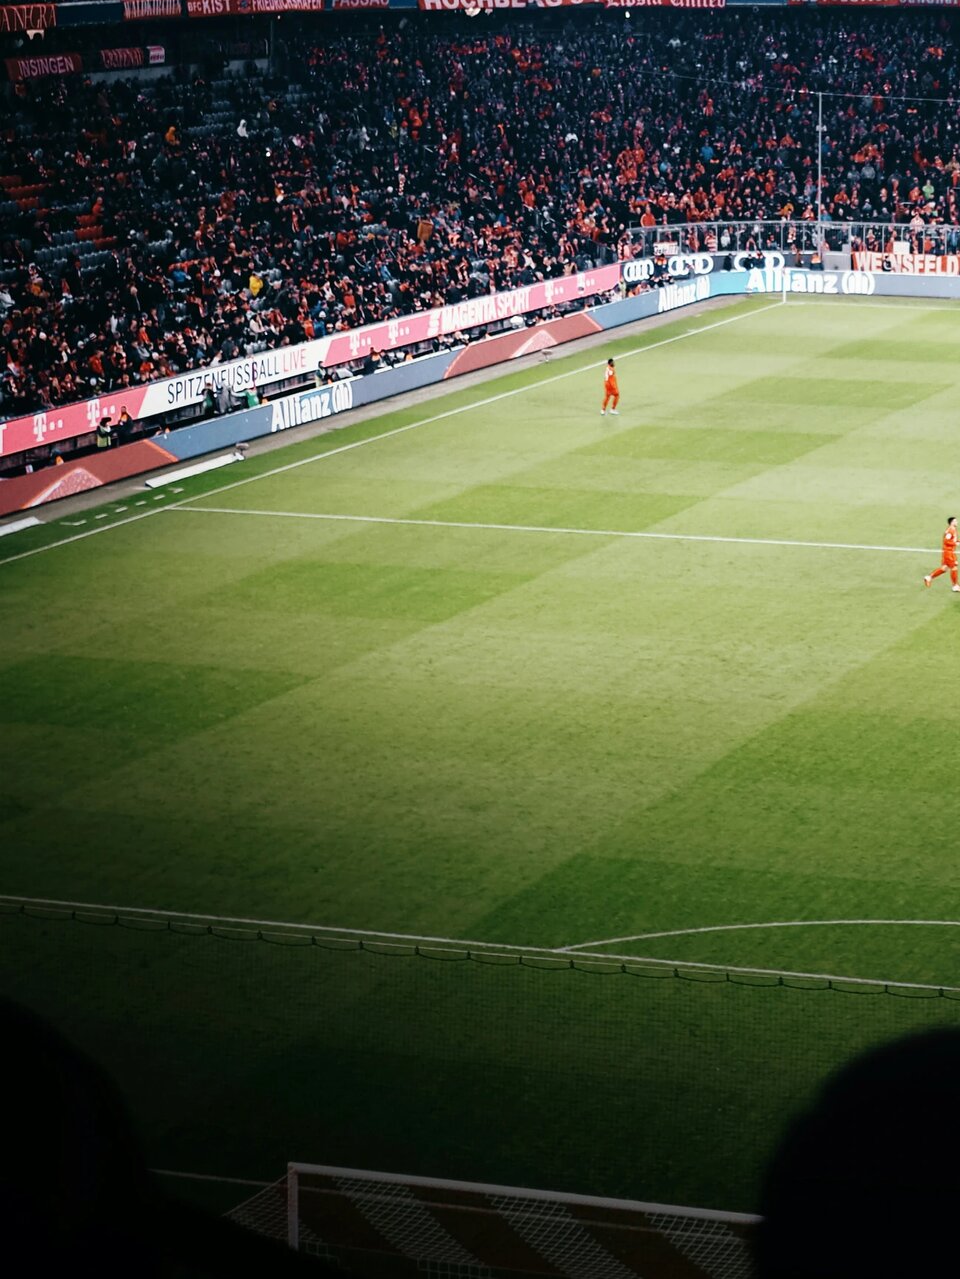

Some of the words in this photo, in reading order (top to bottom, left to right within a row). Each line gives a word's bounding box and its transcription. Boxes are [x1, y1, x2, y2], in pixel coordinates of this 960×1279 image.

[855, 252, 960, 275] WENSFELD
[746, 269, 838, 294] Allianz
[441, 297, 497, 333] MAGENTA
[496, 287, 532, 317] SPORT
[658, 282, 696, 312] Allianz
[282, 348, 307, 372] LIVE
[271, 390, 331, 432] Allianz
